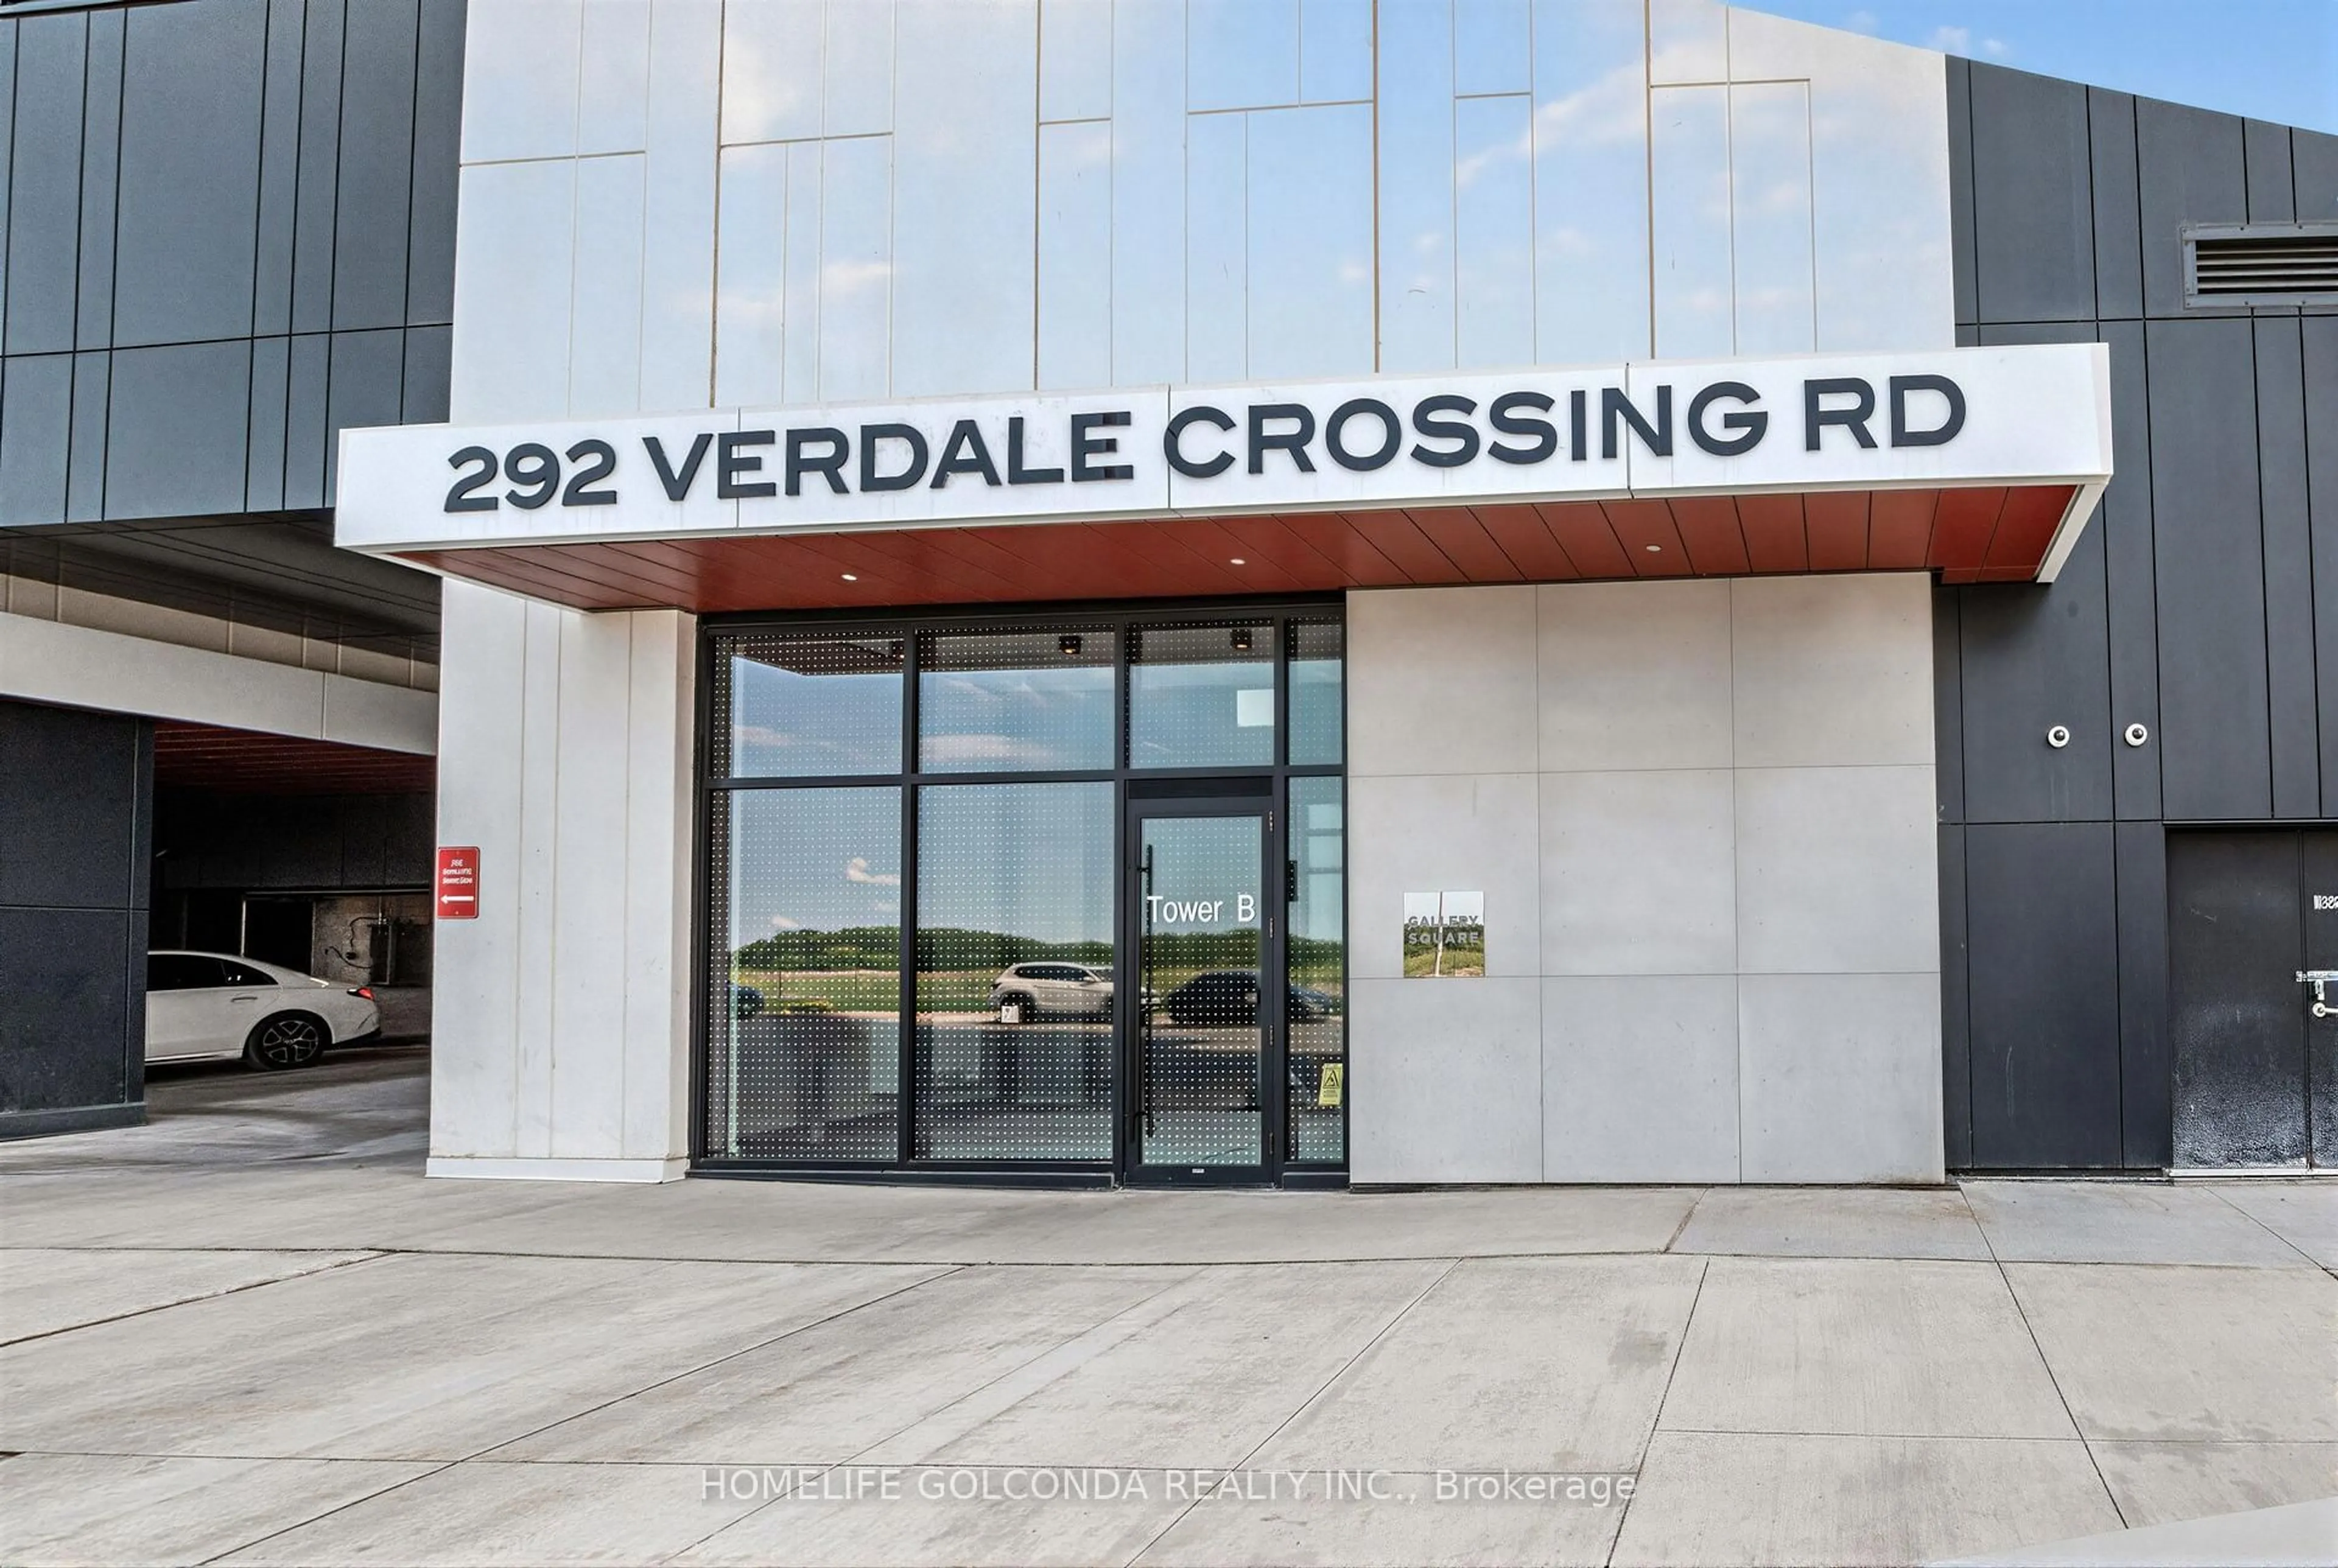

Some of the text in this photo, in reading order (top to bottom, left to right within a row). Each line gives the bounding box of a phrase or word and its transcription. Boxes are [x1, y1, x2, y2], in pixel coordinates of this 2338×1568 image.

[446, 374, 1967, 513] 292 VERDALE CROSSING RD
[1146, 894, 1256, 923] Tower B
[1408, 915, 1479, 928] GALLERY
[1408, 932, 1480, 945] SQUARE
